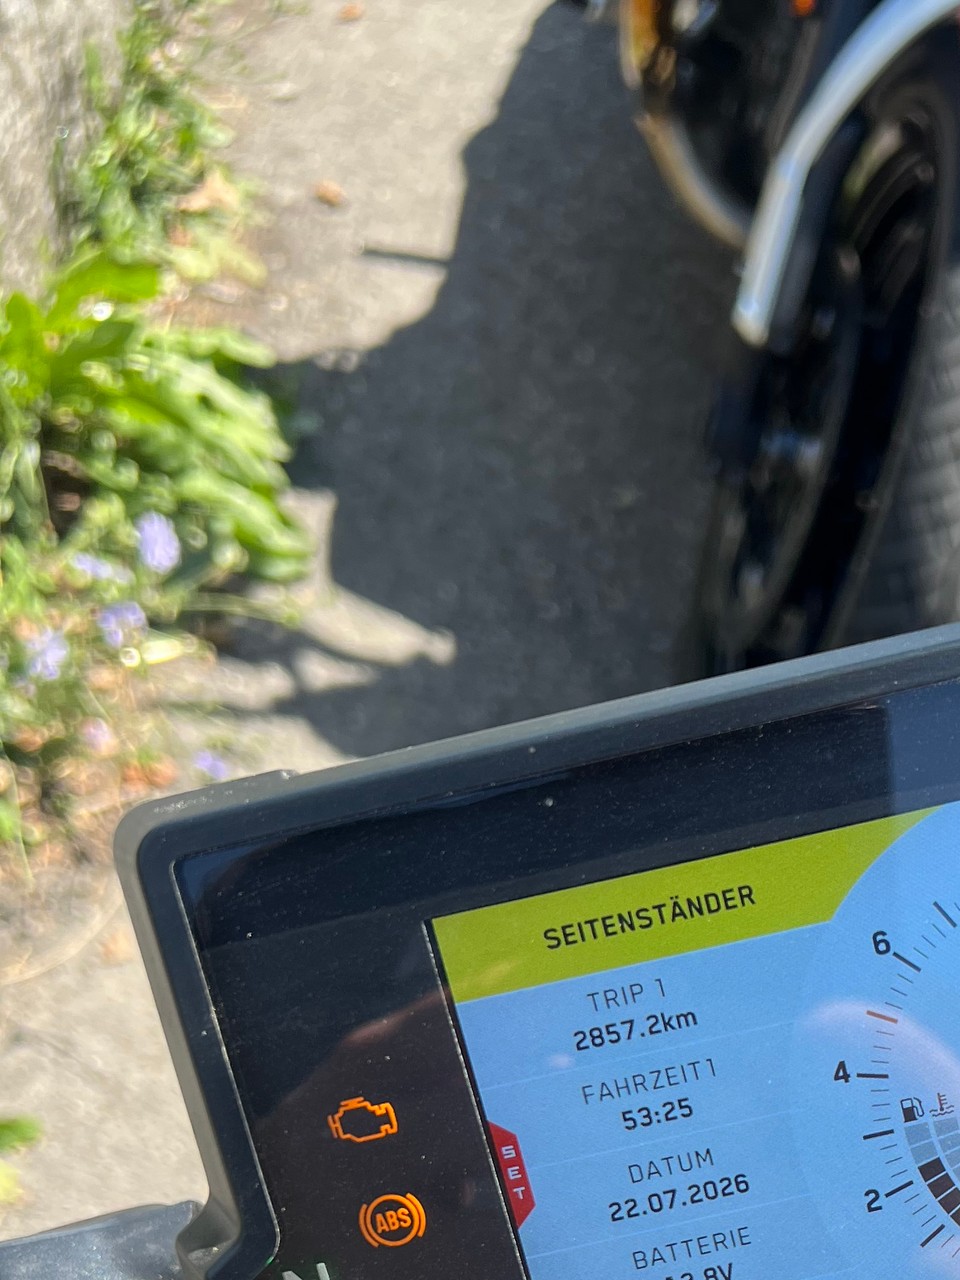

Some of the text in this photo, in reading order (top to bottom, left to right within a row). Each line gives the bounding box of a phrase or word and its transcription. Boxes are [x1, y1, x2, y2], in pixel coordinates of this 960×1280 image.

[543, 885, 755, 950] SEITENSTÄNDER
[872, 931, 890, 955] 6
[587, 978, 667, 1013] TRIP 1
[573, 1009, 698, 1052] 2857.2km
[832, 1061, 851, 1084] 4
[621, 1099, 694, 1131] 53:25
[501, 1145, 526, 1200] SET
[628, 1148, 715, 1185] DATUM
[608, 1174, 751, 1224] 22.07.2026
[864, 1190, 883, 1212] 2
[375, 1208, 412, 1234] ABS
[631, 1226, 753, 1271] BATTERIE
